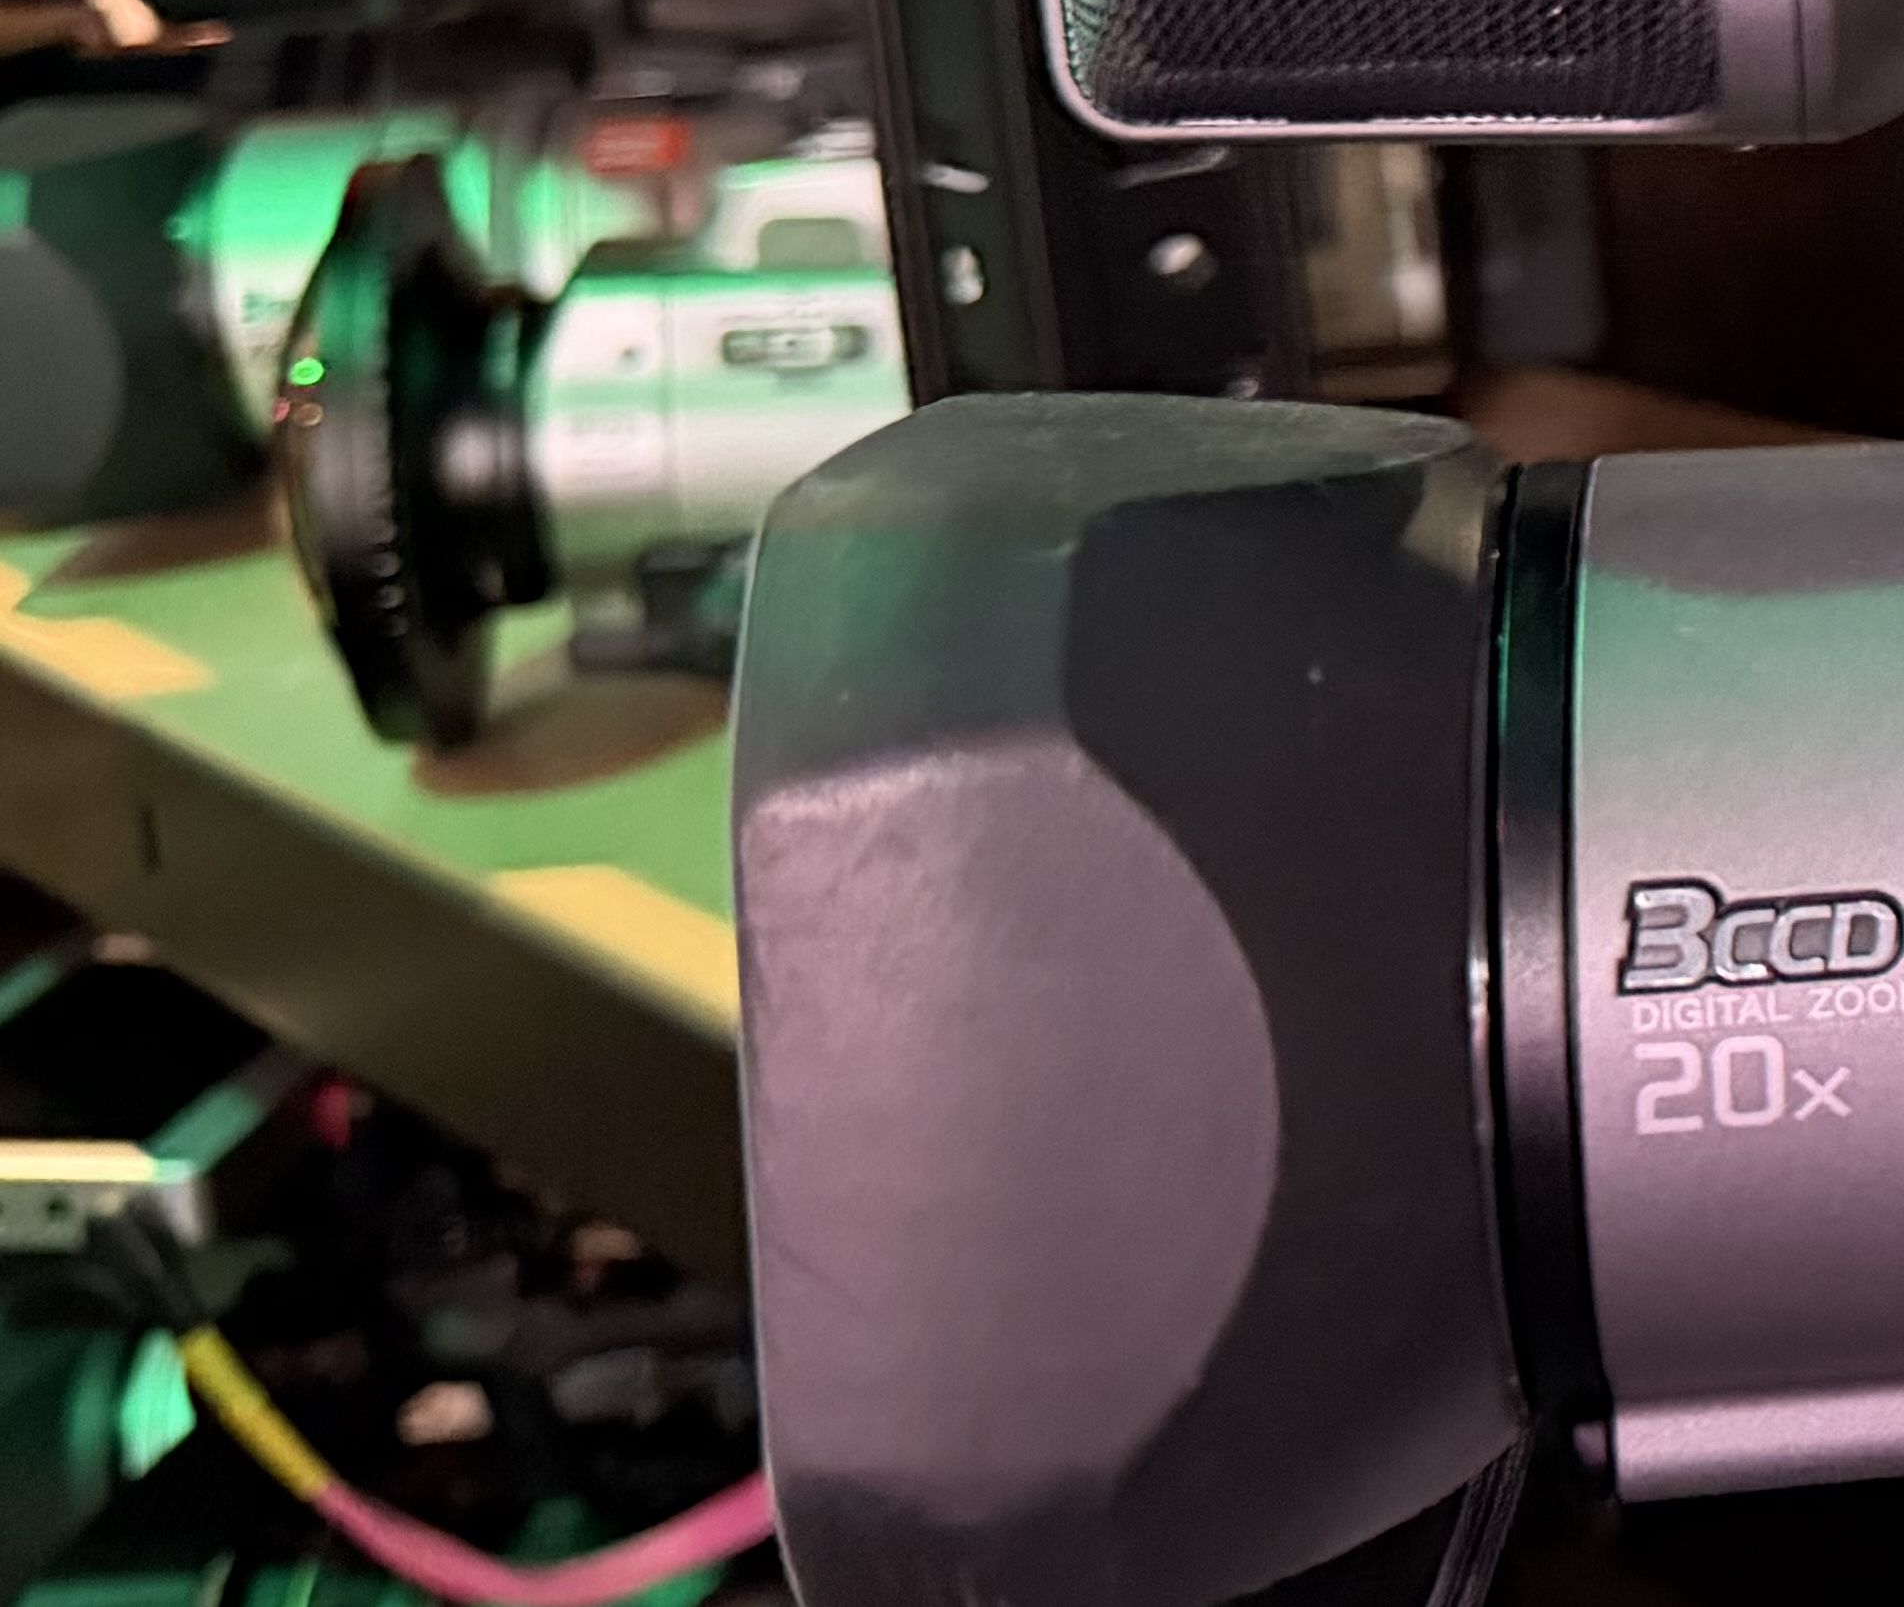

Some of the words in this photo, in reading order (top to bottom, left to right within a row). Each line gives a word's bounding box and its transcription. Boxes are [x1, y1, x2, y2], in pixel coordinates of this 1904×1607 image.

[1620, 882, 1904, 994] 3CCD
[1631, 991, 1792, 1034] DIGITAL
[1633, 1035, 1852, 1136] 20x
